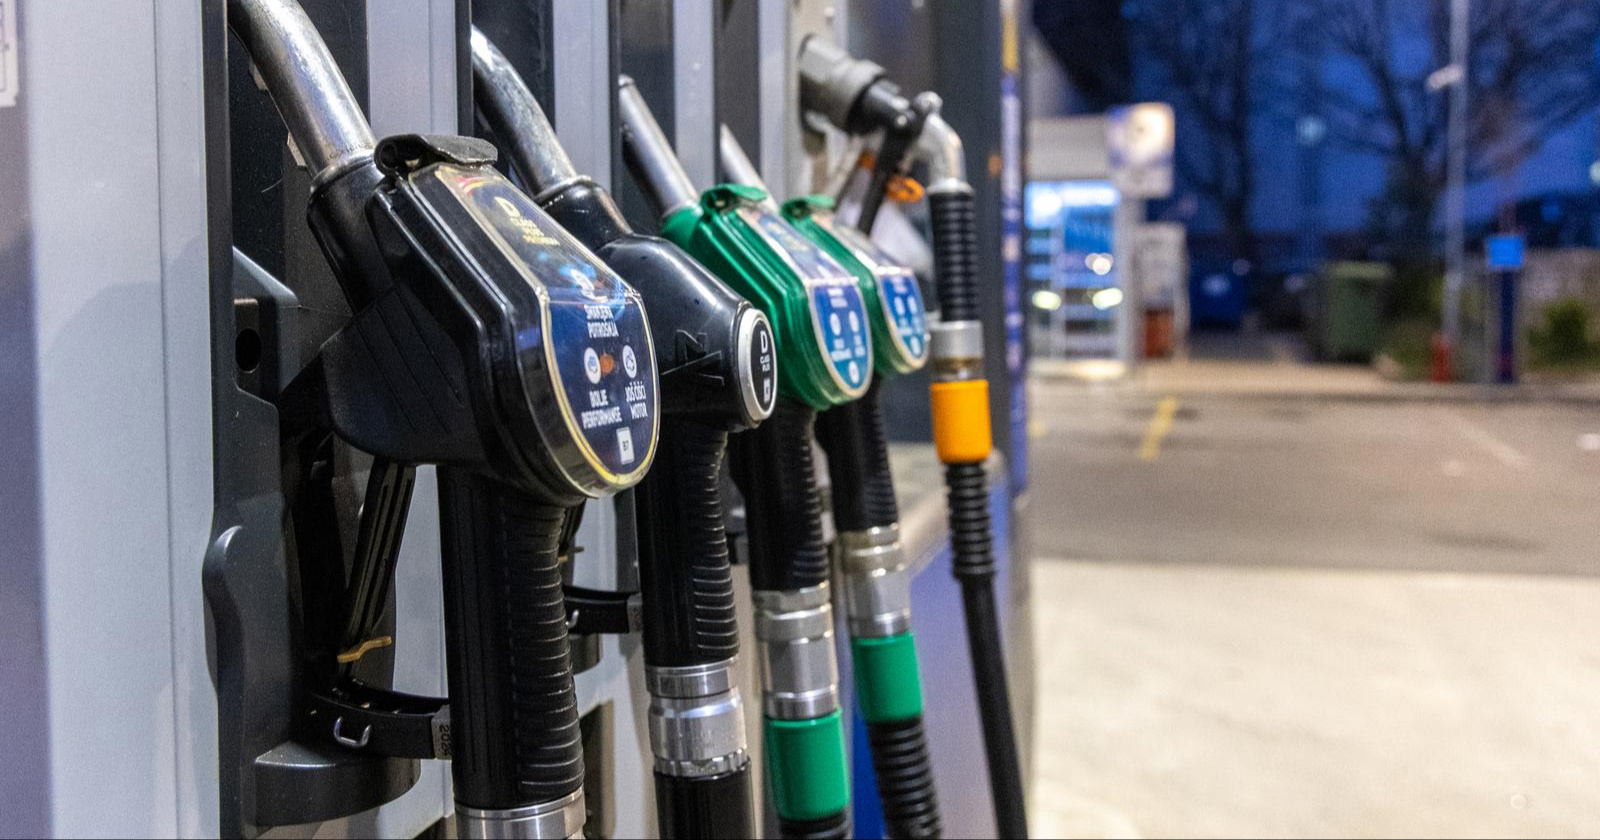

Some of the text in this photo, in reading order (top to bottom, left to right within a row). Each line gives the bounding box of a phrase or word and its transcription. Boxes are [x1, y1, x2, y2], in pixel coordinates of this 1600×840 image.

[495, 196, 521, 217] D
[760, 330, 768, 354] D
[589, 389, 609, 408] BOLJE
[630, 402, 648, 420] MOTOR
